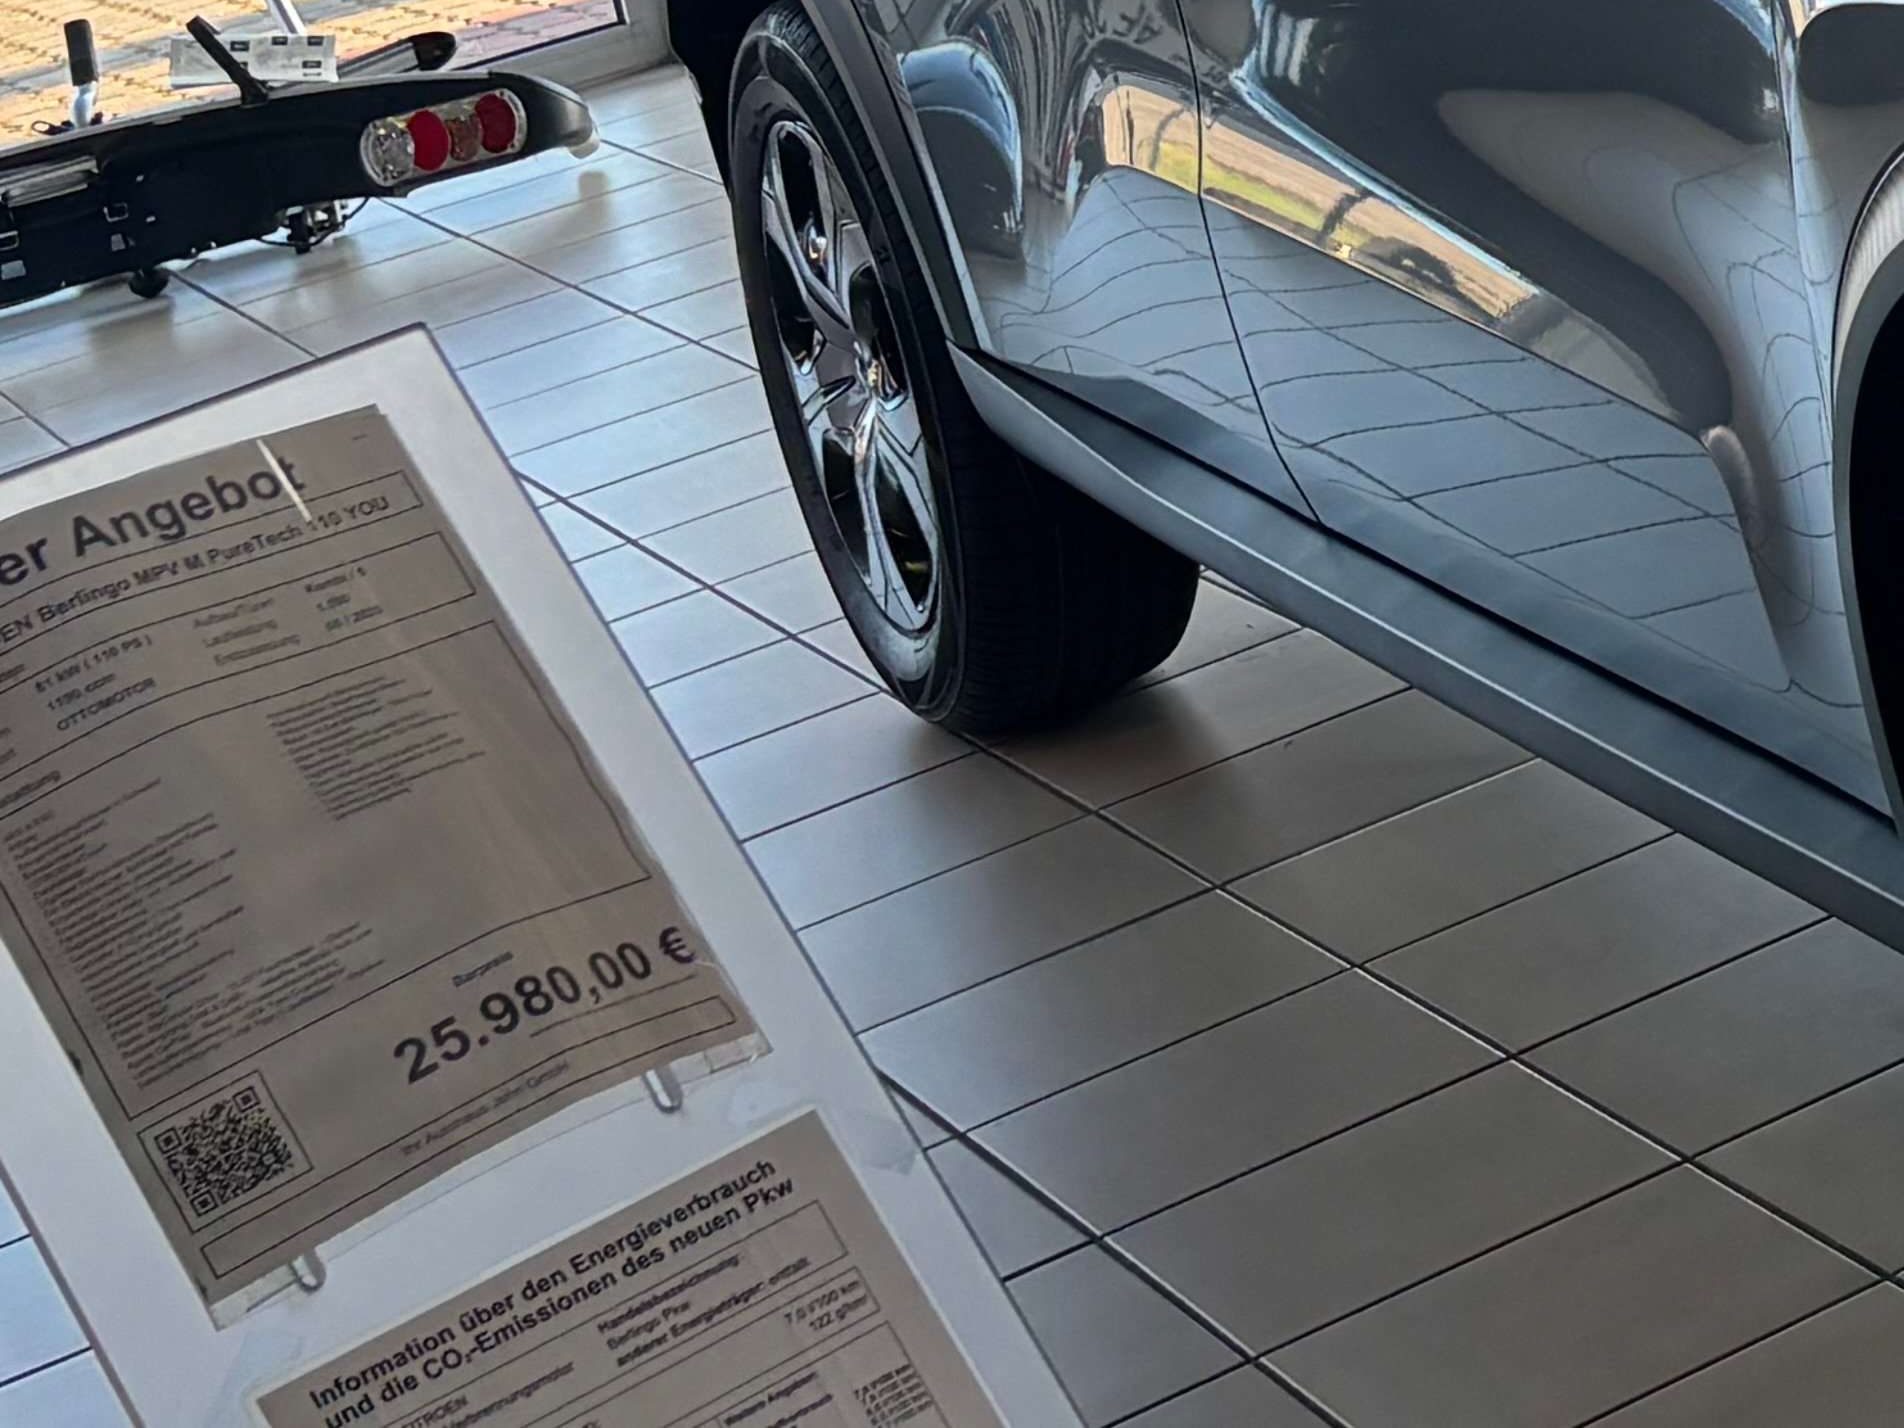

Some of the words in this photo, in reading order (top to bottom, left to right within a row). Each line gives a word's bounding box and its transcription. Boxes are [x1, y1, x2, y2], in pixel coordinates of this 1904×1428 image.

[37, 576, 131, 622] Berlingo
[208, 523, 304, 565] PureTech
[344, 495, 391, 521] YOU
[69, 455, 306, 559] Angebot
[393, 942, 653, 1085] 25.980,00
[658, 925, 697, 965] €
[309, 1324, 456, 1409] Information
[458, 1291, 516, 1334] über
[520, 1267, 569, 1304] den
[569, 1160, 777, 1278] Energieverbrauch
[324, 1392, 376, 1428] und
[379, 1370, 419, 1405] die
[620, 1245, 667, 1280] des
[668, 1206, 742, 1256] neuen
[742, 1176, 796, 1214] Pkw
